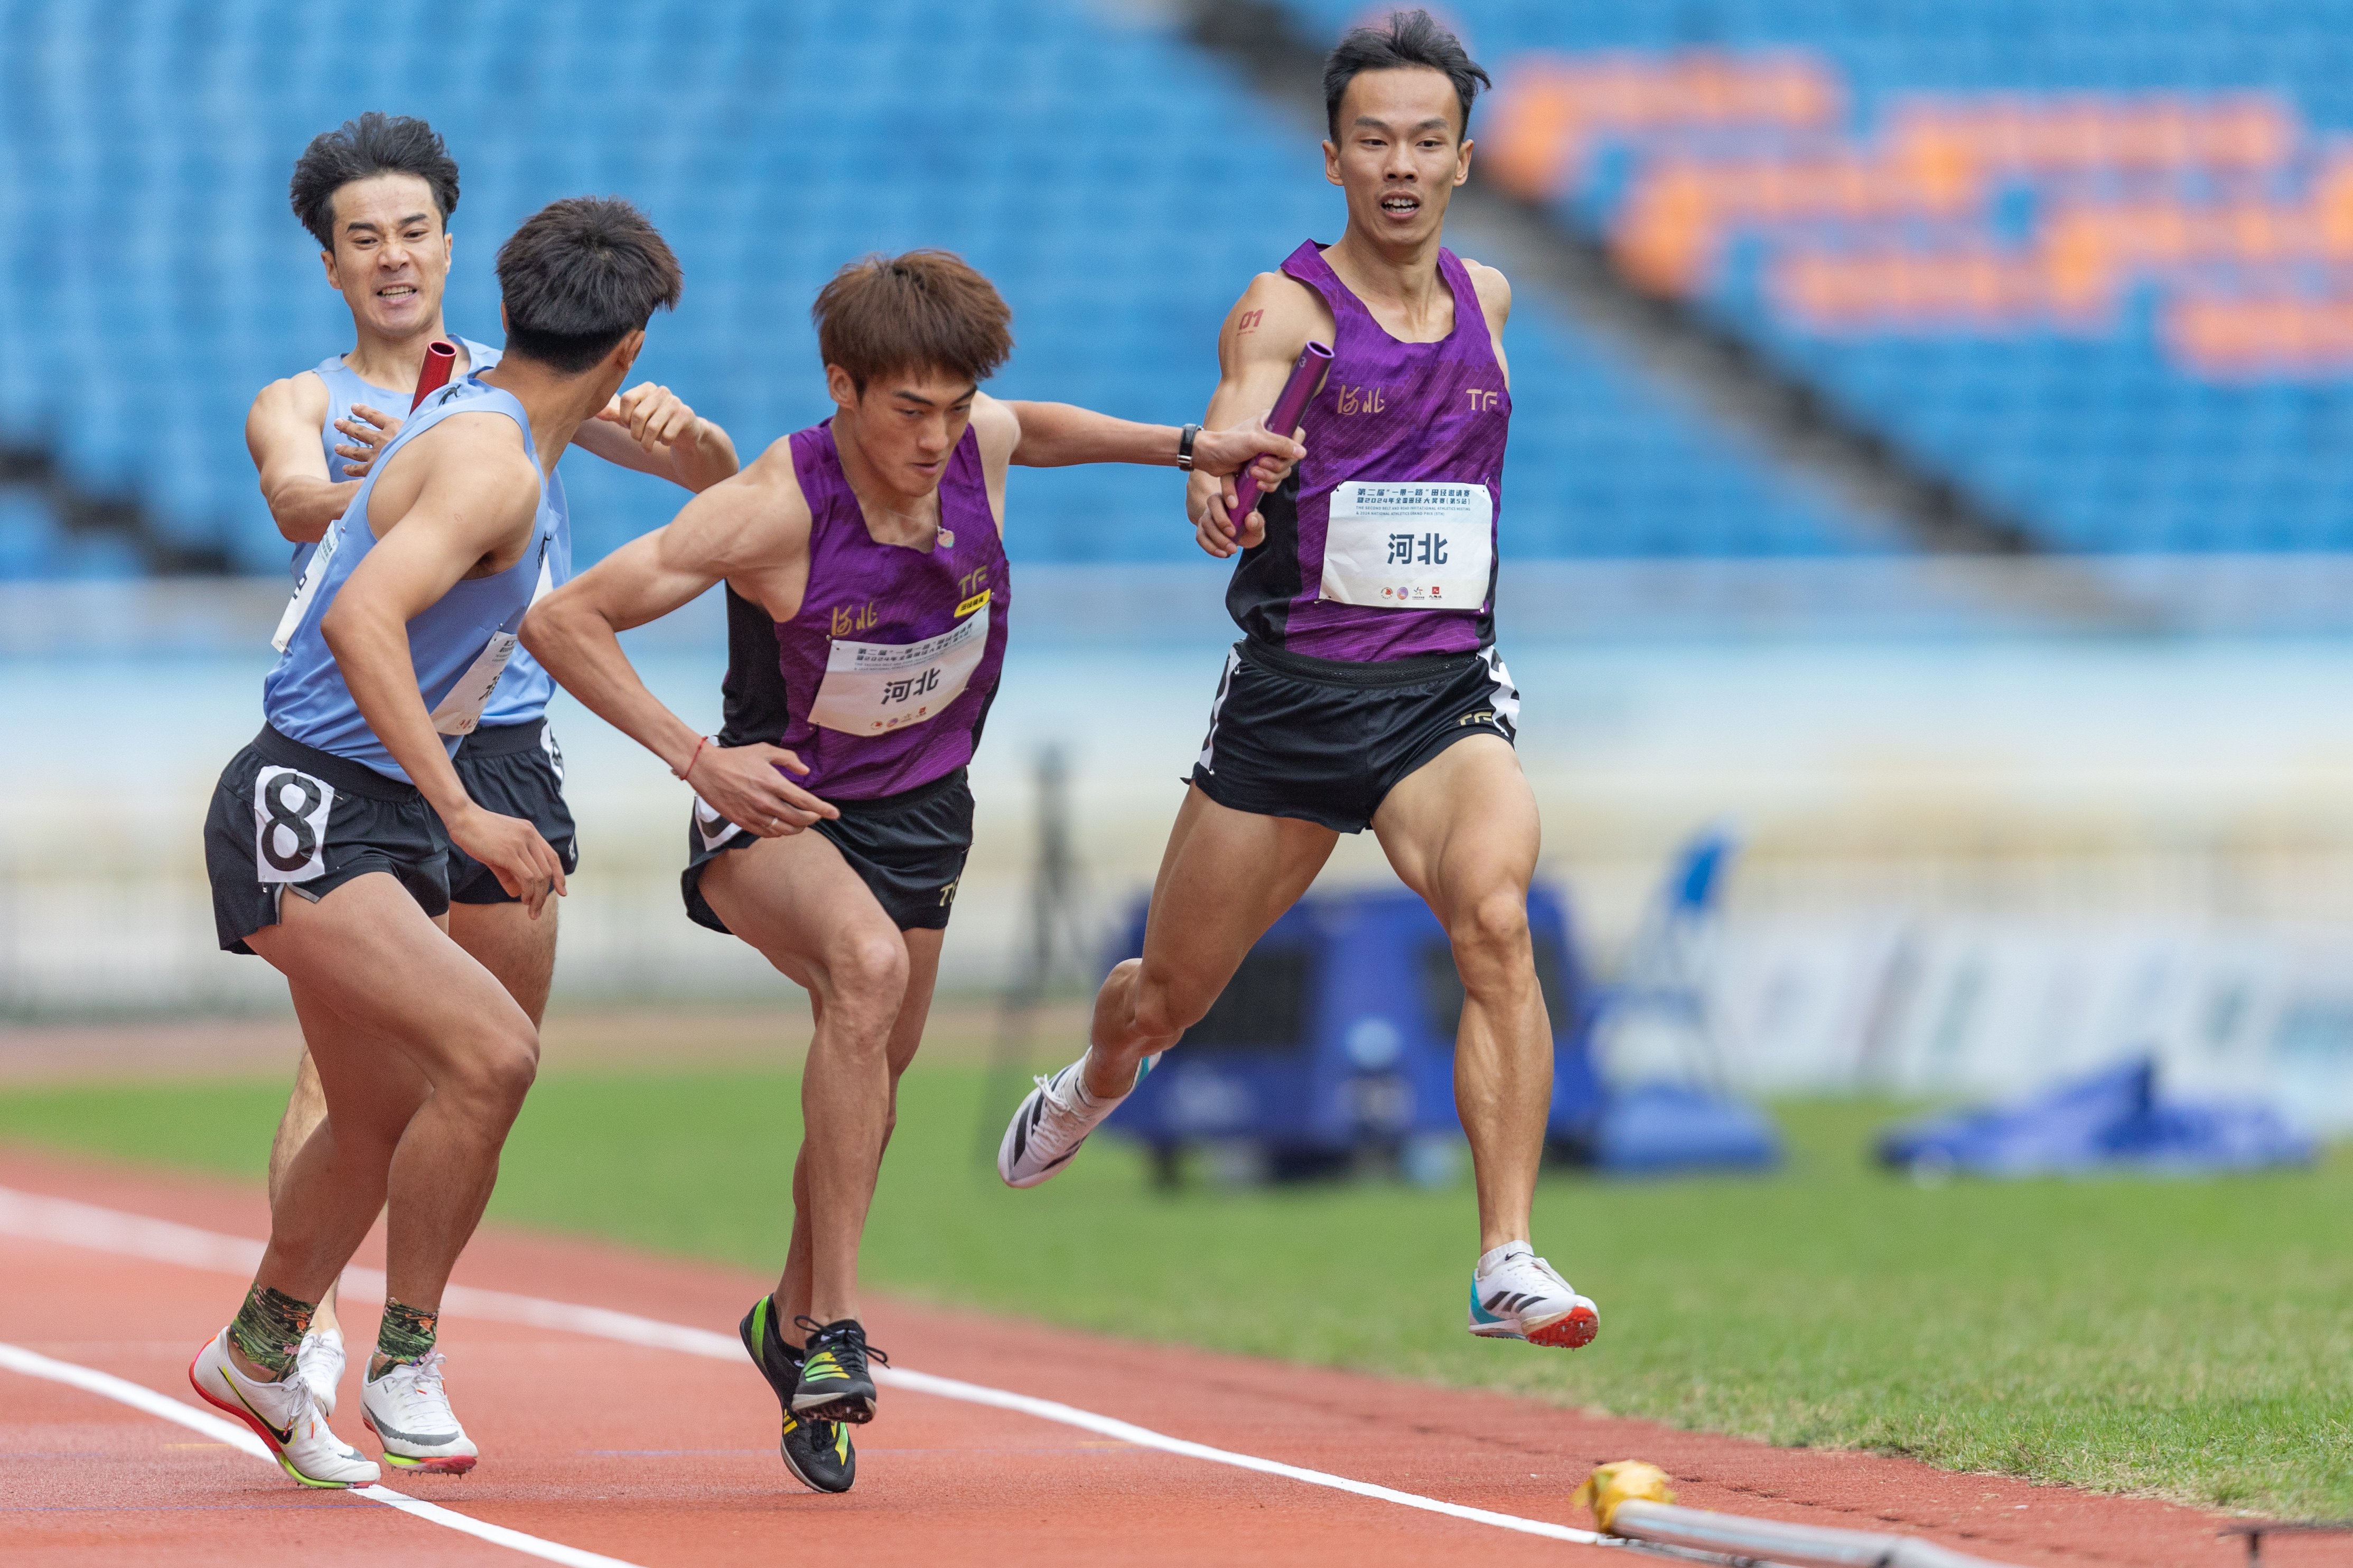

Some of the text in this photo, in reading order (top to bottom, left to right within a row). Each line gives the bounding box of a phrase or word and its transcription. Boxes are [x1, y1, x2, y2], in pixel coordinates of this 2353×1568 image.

[1239, 309, 1264, 330] 01
[1299, 356, 1307, 368] 3
[1466, 389, 1498, 411] TF
[1387, 532, 1448, 565] 河北
[881, 668, 940, 705] 河北
[261, 772, 321, 871] 8
